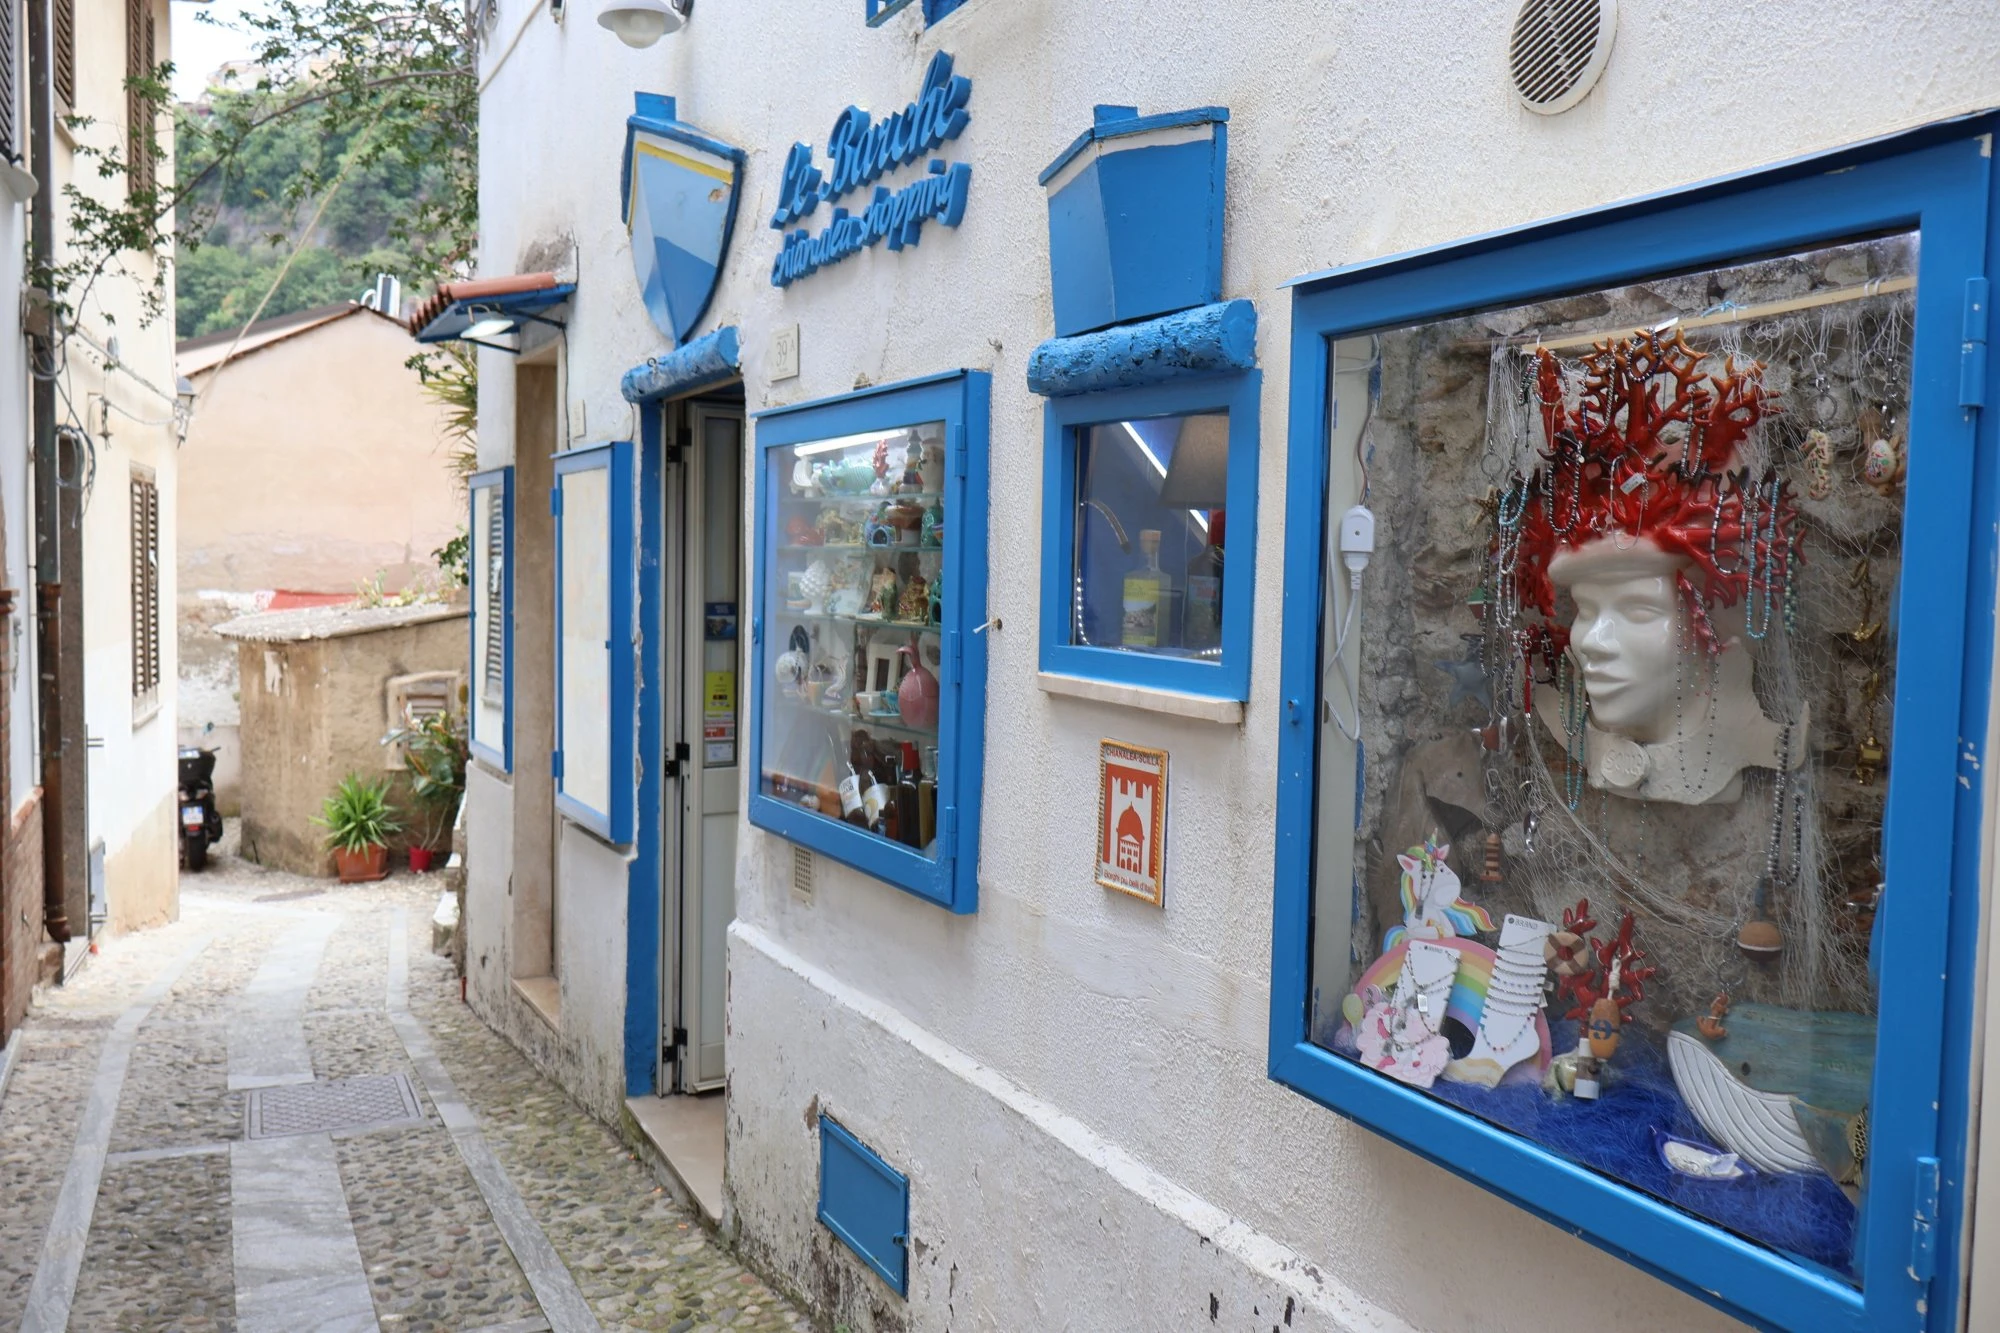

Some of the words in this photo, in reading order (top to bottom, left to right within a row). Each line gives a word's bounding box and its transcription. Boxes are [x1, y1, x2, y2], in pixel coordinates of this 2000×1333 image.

[770, 141, 822, 229] Le
[818, 49, 972, 203] Barche
[771, 208, 861, 287] chianalea
[856, 159, 972, 251] shopping
[776, 340, 787, 367] 39
[1104, 869, 1120, 881] Borghi
[1514, 919, 1538, 929] BRAND
